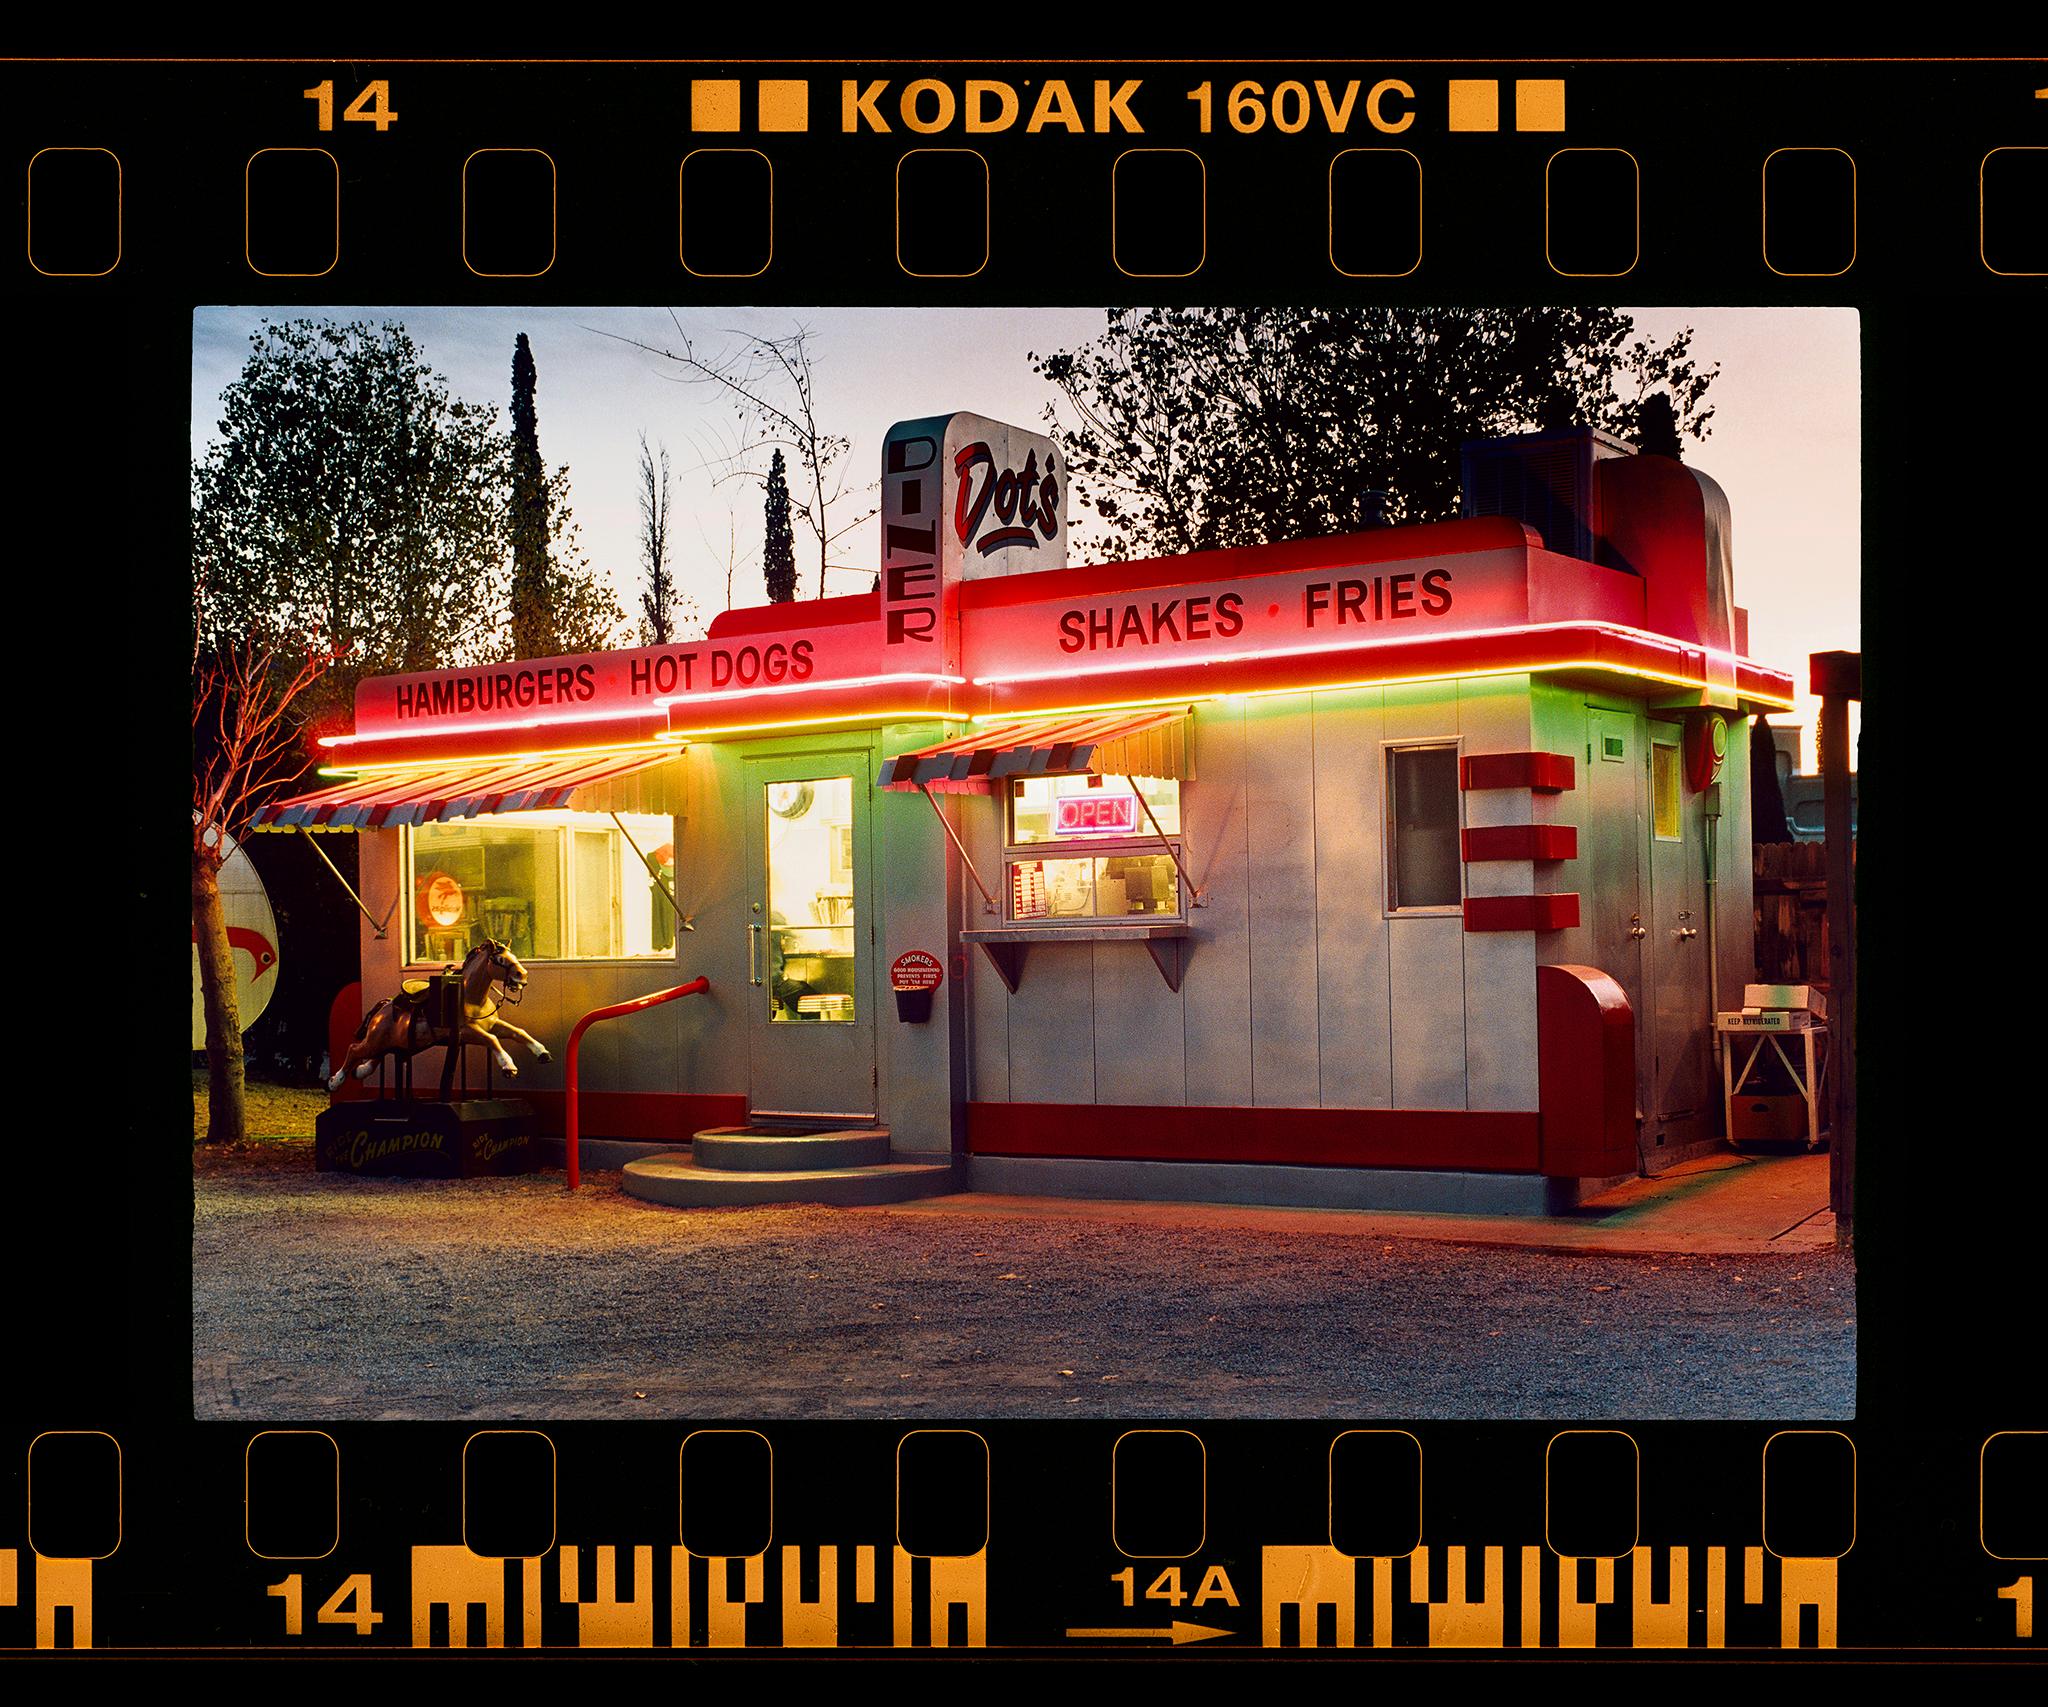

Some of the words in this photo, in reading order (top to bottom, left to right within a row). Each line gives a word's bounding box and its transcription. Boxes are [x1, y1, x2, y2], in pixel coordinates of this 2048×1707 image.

[303, 80, 398, 132] 14
[841, 79, 1145, 134] KODAK
[1187, 79, 1416, 134] 160VC
[955, 441, 1059, 549] Dot's
[887, 435, 937, 645] DINER
[1059, 592, 1244, 654] SHAKES
[1304, 569, 1452, 629] FRIES
[396, 663, 595, 720] HAMBURGERS
[631, 653, 698, 696] HOT
[710, 640, 814, 687] DOGS
[1060, 800, 1129, 828] OPEN
[901, 955, 933, 967] SMOKERS
[351, 1130, 443, 1168] CHAMPION
[485, 1136, 529, 1160] CHAMPION
[266, 1574, 384, 1635] 14
[1111, 1565, 1241, 1607] 14A
